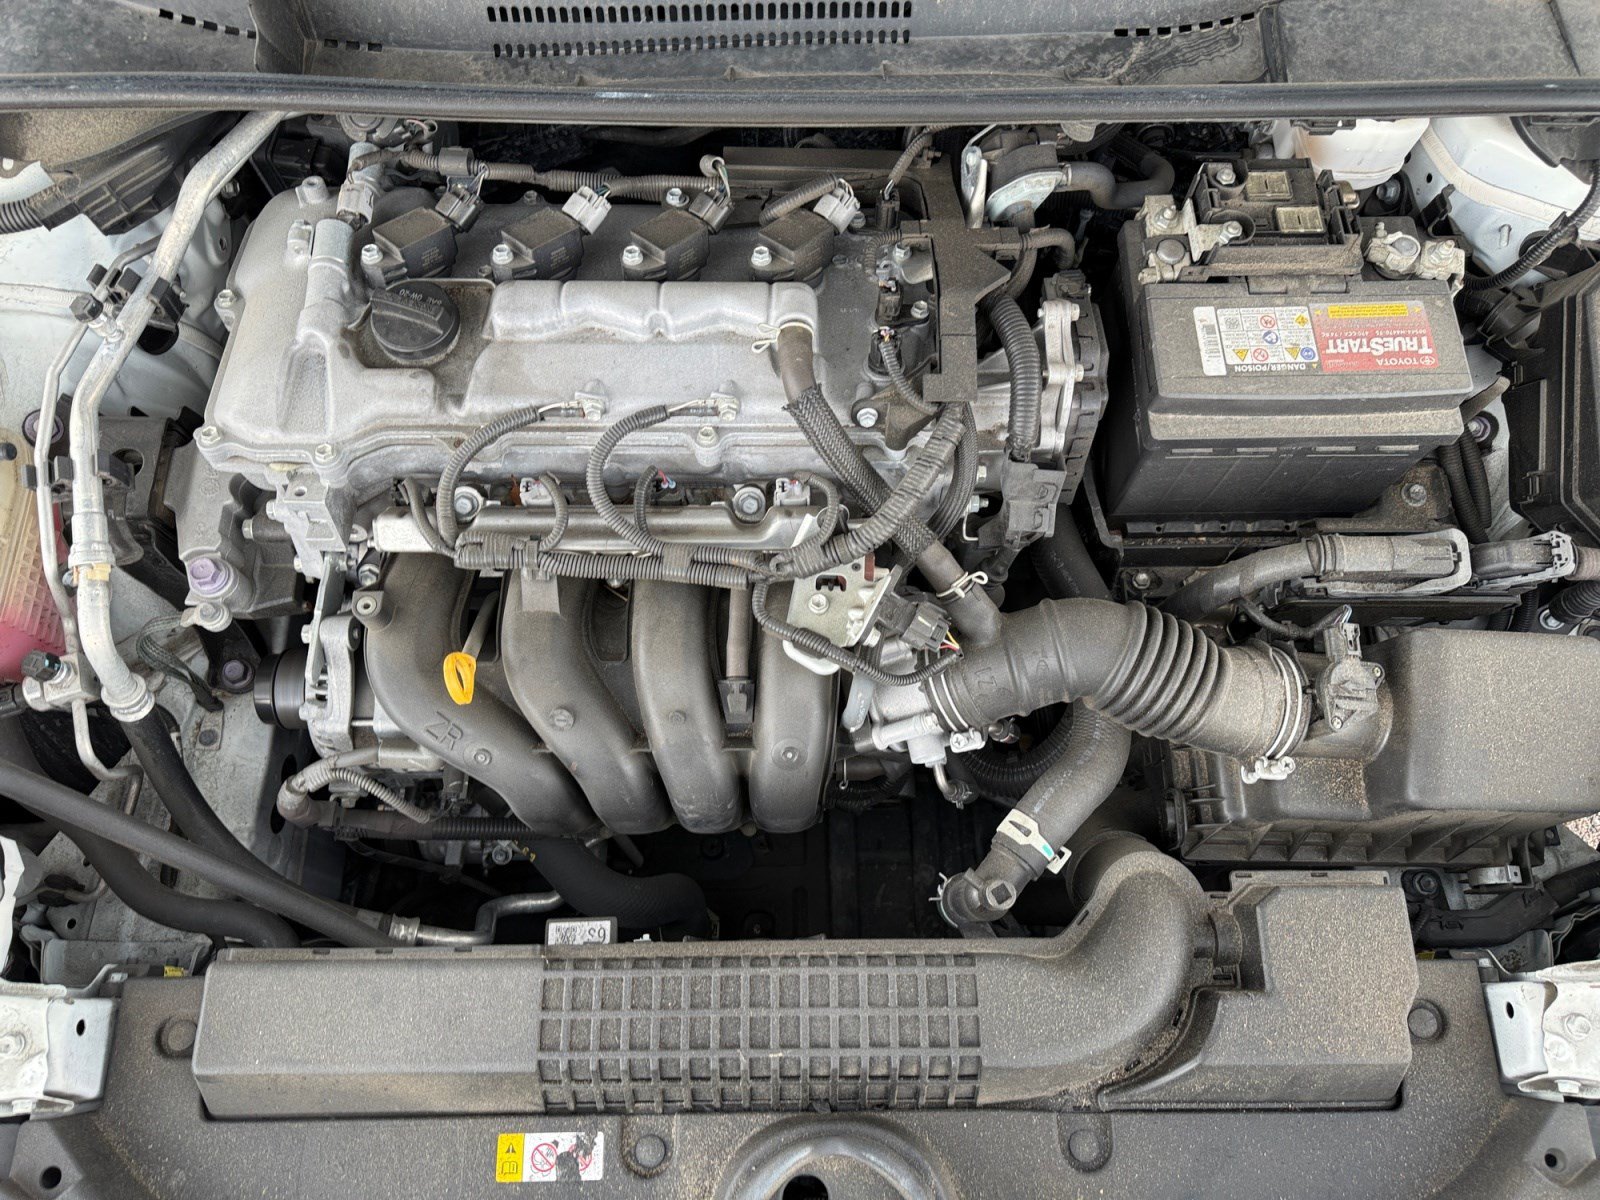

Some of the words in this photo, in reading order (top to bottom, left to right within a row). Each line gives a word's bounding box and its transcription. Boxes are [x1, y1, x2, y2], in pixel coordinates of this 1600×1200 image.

[1376, 357, 1419, 366] TOYOTA
[1234, 363, 1306, 372] DANGER/POISON
[425, 710, 464, 751] ZR
